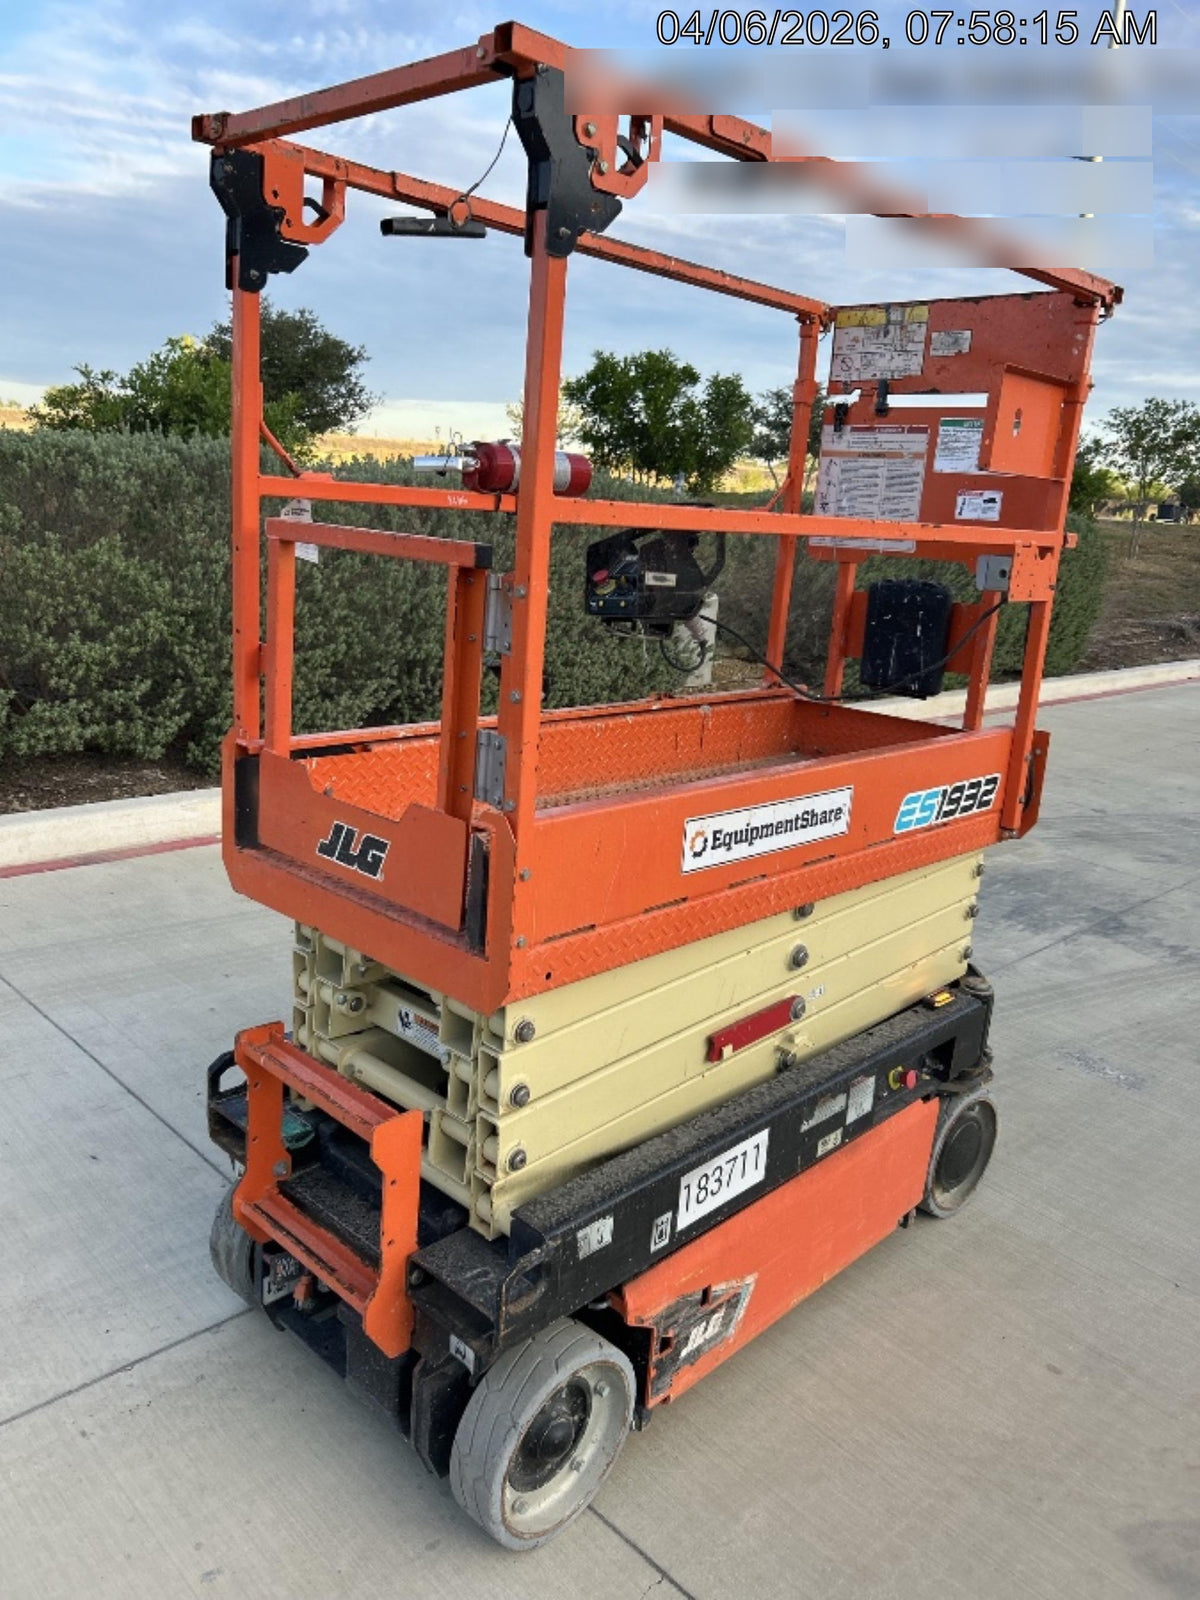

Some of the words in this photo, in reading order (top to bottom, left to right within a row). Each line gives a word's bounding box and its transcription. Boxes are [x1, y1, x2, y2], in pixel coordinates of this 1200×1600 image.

[711, 808, 843, 851] EquipmentShare
[896, 774, 1000, 832] ES1932
[316, 821, 391, 880] JLG
[683, 1142, 761, 1214] 183711
